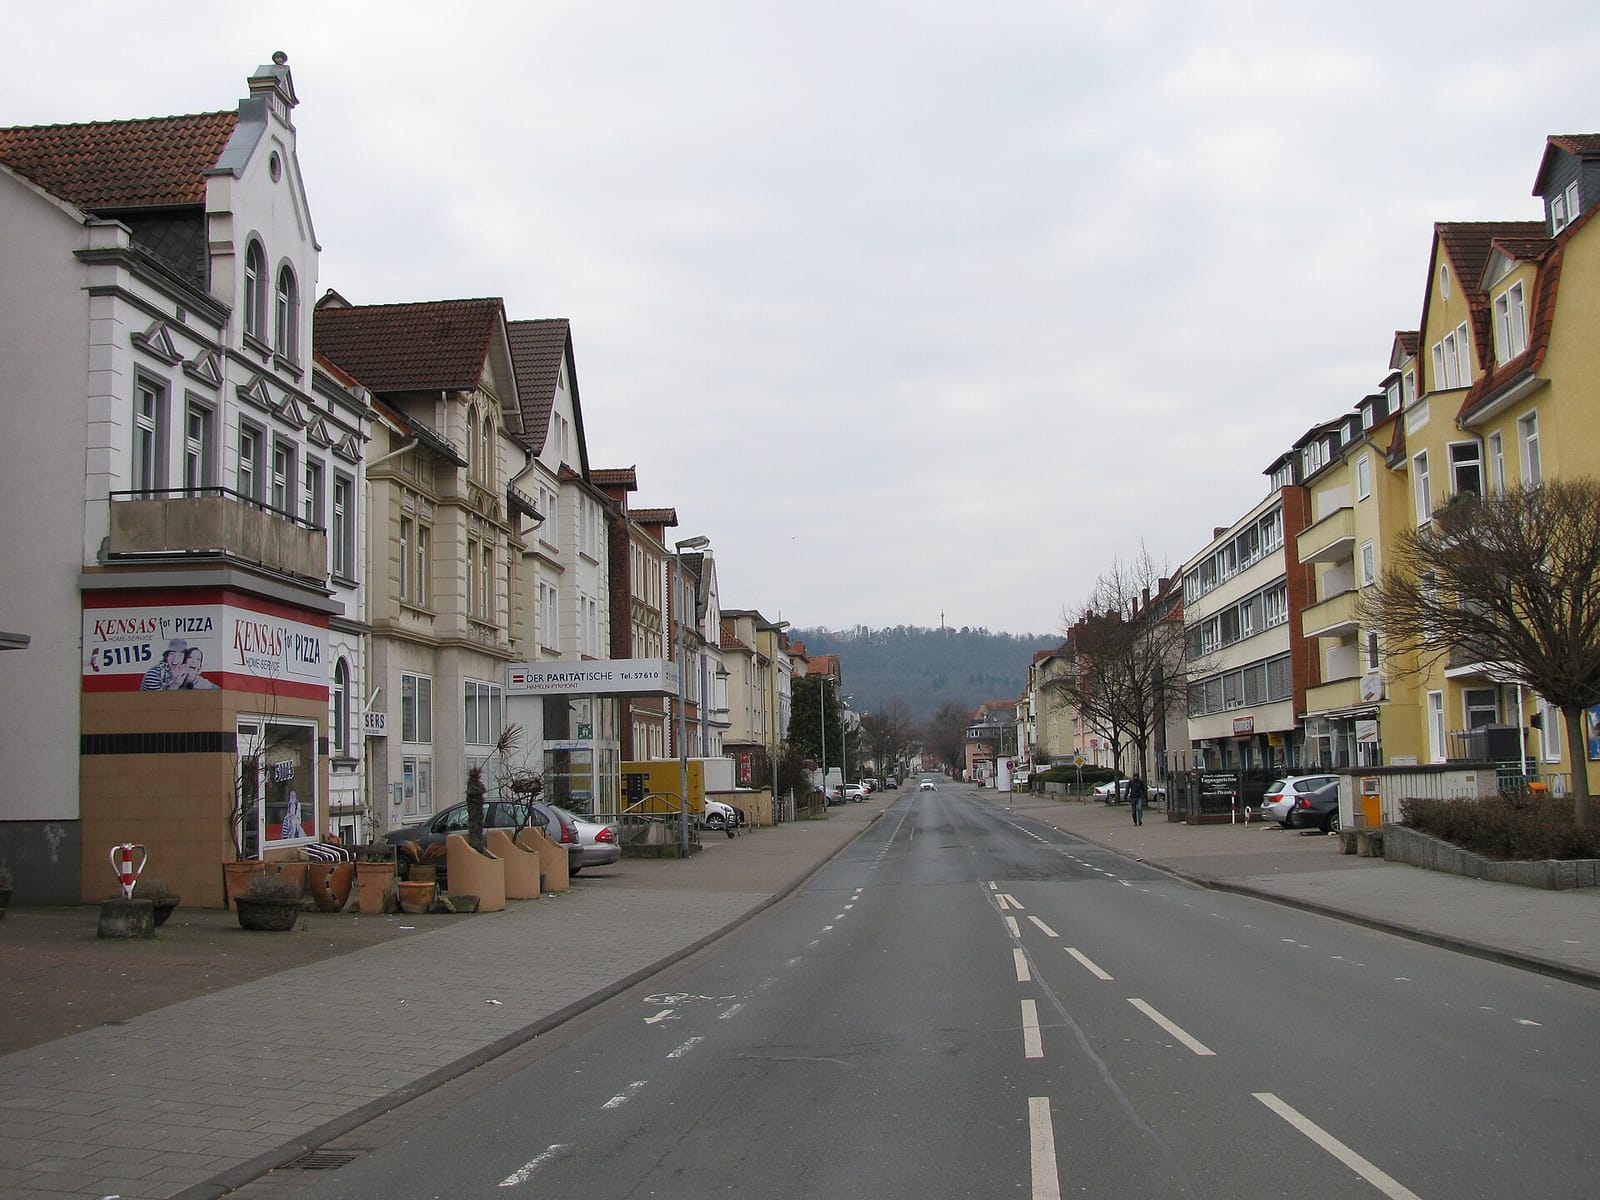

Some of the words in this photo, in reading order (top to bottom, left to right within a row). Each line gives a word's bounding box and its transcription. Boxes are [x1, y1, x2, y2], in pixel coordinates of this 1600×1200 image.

[94, 616, 157, 641] KENSAS
[159, 617, 171, 640] for
[175, 616, 213, 632] PIZZA
[103, 643, 152, 667] 51115
[233, 619, 283, 666] KENSAS
[284, 628, 293, 672] for
[295, 633, 321, 664] PIZZA
[526, 674, 544, 683] DER
[546, 671, 613, 682] PARITÄTISCHE
[620, 672, 633, 680] Tel.
